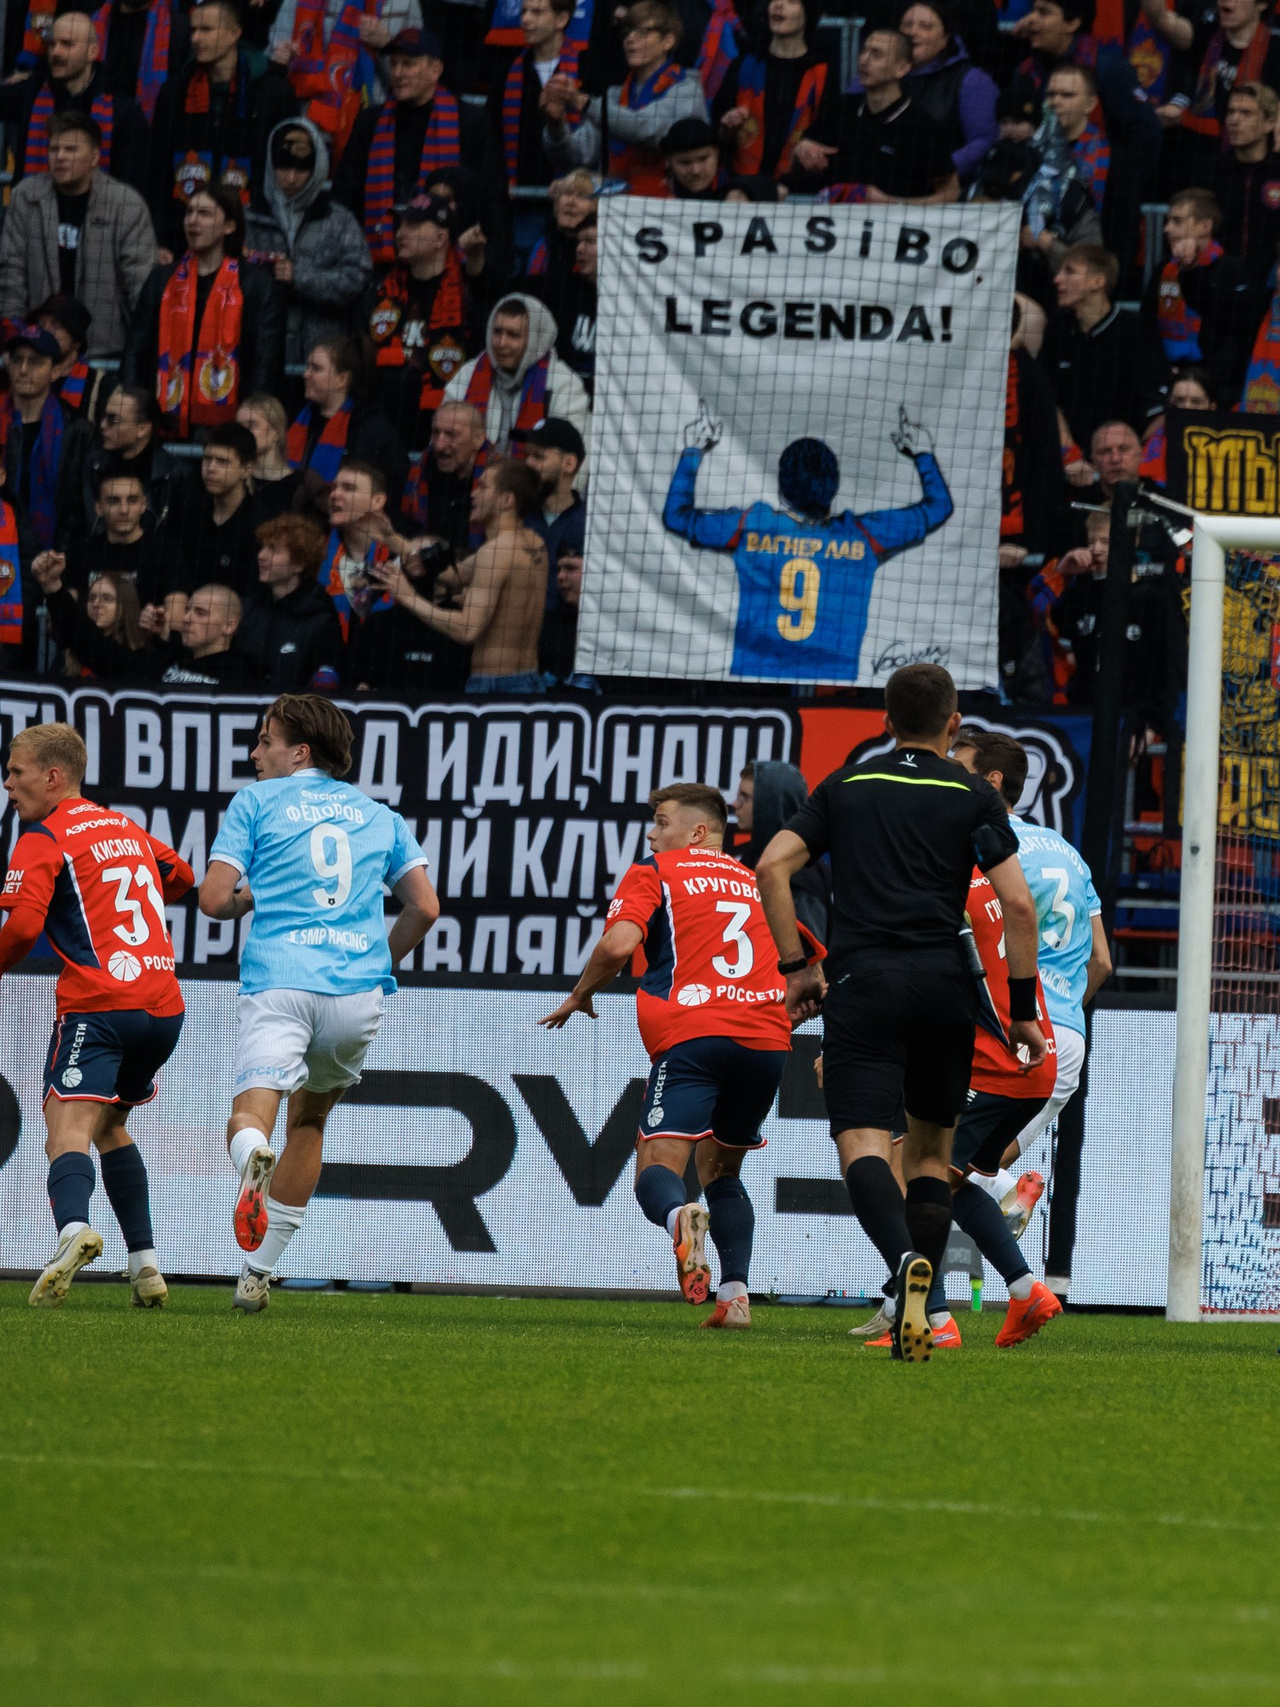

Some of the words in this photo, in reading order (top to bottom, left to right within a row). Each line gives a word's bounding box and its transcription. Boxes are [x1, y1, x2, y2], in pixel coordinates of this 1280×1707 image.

[664, 297, 953, 342] LEGENDA!
[746, 532, 820, 559] ВАГНЕР
[824, 536, 865, 561] ЛАВ
[776, 557, 821, 642] 9
[124, 708, 403, 806] ВПЕД
[426, 720, 589, 811] ИДИ,
[611, 723, 775, 804] НАШ
[66, 818, 121, 836] АЭРОФЛОТ
[286, 801, 365, 824] ФЁДОРОВ
[90, 838, 143, 863] КИСЛЯК
[310, 823, 353, 909] 9
[511, 818, 655, 899] КЛУ
[101, 864, 169, 947] 31
[1042, 867, 1075, 950] 3
[328, 930, 369, 951] RACING
[711, 900, 754, 978] 3
[1040, 966, 1073, 998] RACING
[69, 1023, 87, 1066] РОССЕТИ
